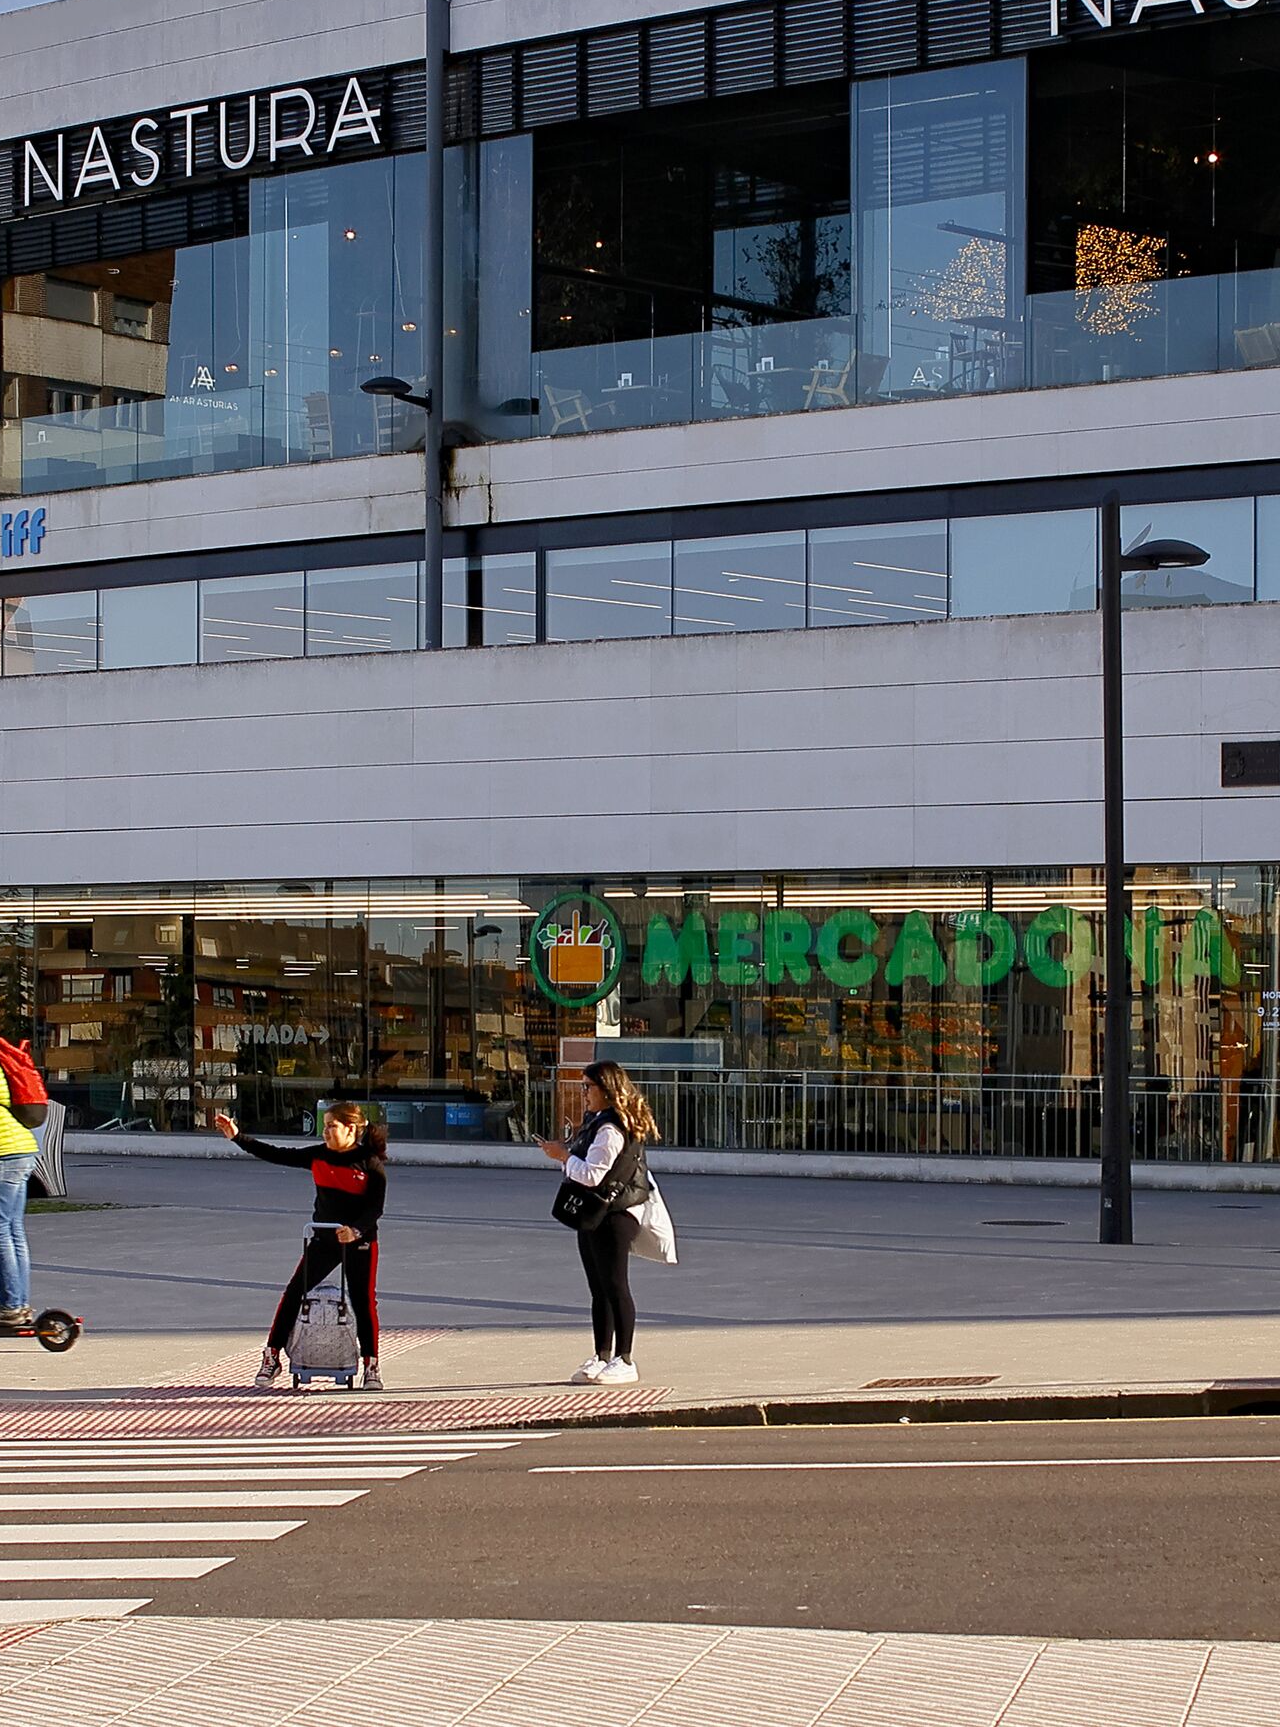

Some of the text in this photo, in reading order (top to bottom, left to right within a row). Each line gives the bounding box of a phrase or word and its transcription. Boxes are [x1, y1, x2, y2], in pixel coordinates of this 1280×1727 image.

[23, 77, 381, 207] NASTURA
[196, 397, 239, 411] ASTURIAS
[1257, 1006, 1265, 1017] 9
